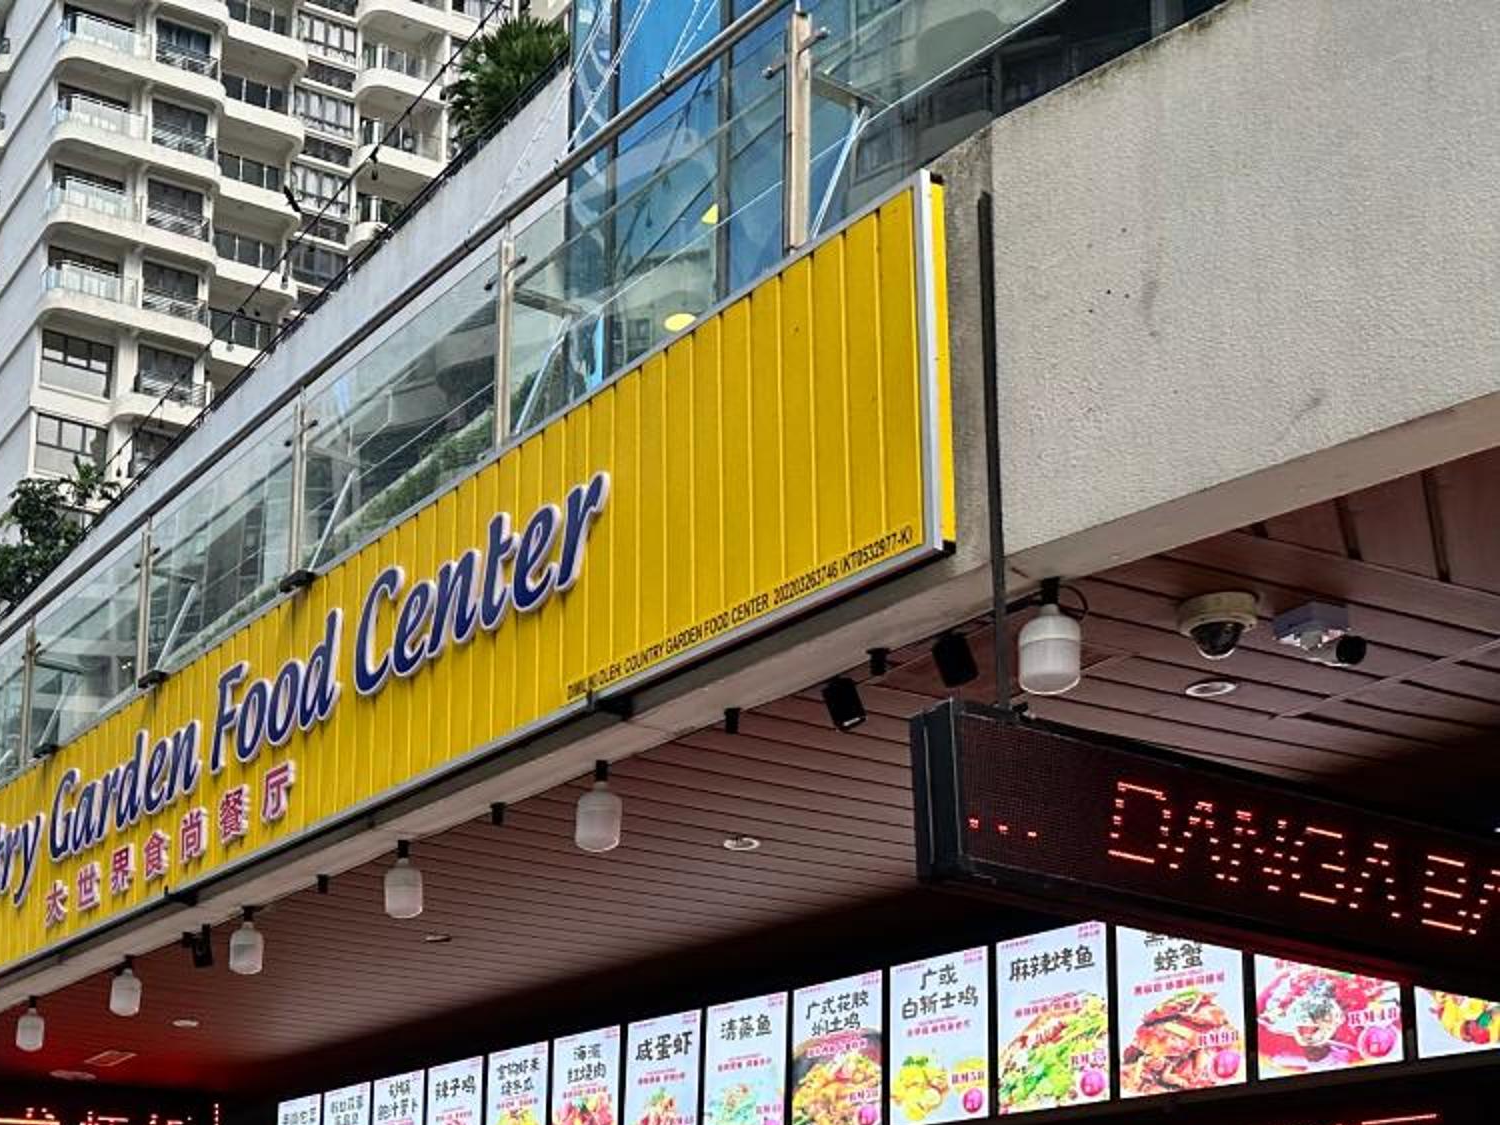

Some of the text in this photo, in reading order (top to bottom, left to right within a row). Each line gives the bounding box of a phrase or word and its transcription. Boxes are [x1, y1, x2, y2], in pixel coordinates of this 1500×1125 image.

[50, 719, 203, 864] Garden
[210, 608, 343, 774] Food
[353, 470, 612, 696] Center
[624, 641, 664, 674] COUNTRY
[665, 622, 703, 655] GARDEN
[703, 611, 730, 638] FOOD
[731, 593, 769, 625] CENTER
[44, 758, 297, 925] 大世界食尚餐厅
[1107, 780, 1401, 920] DANGA
[1009, 944, 1097, 982] 麻辣烤鱼
